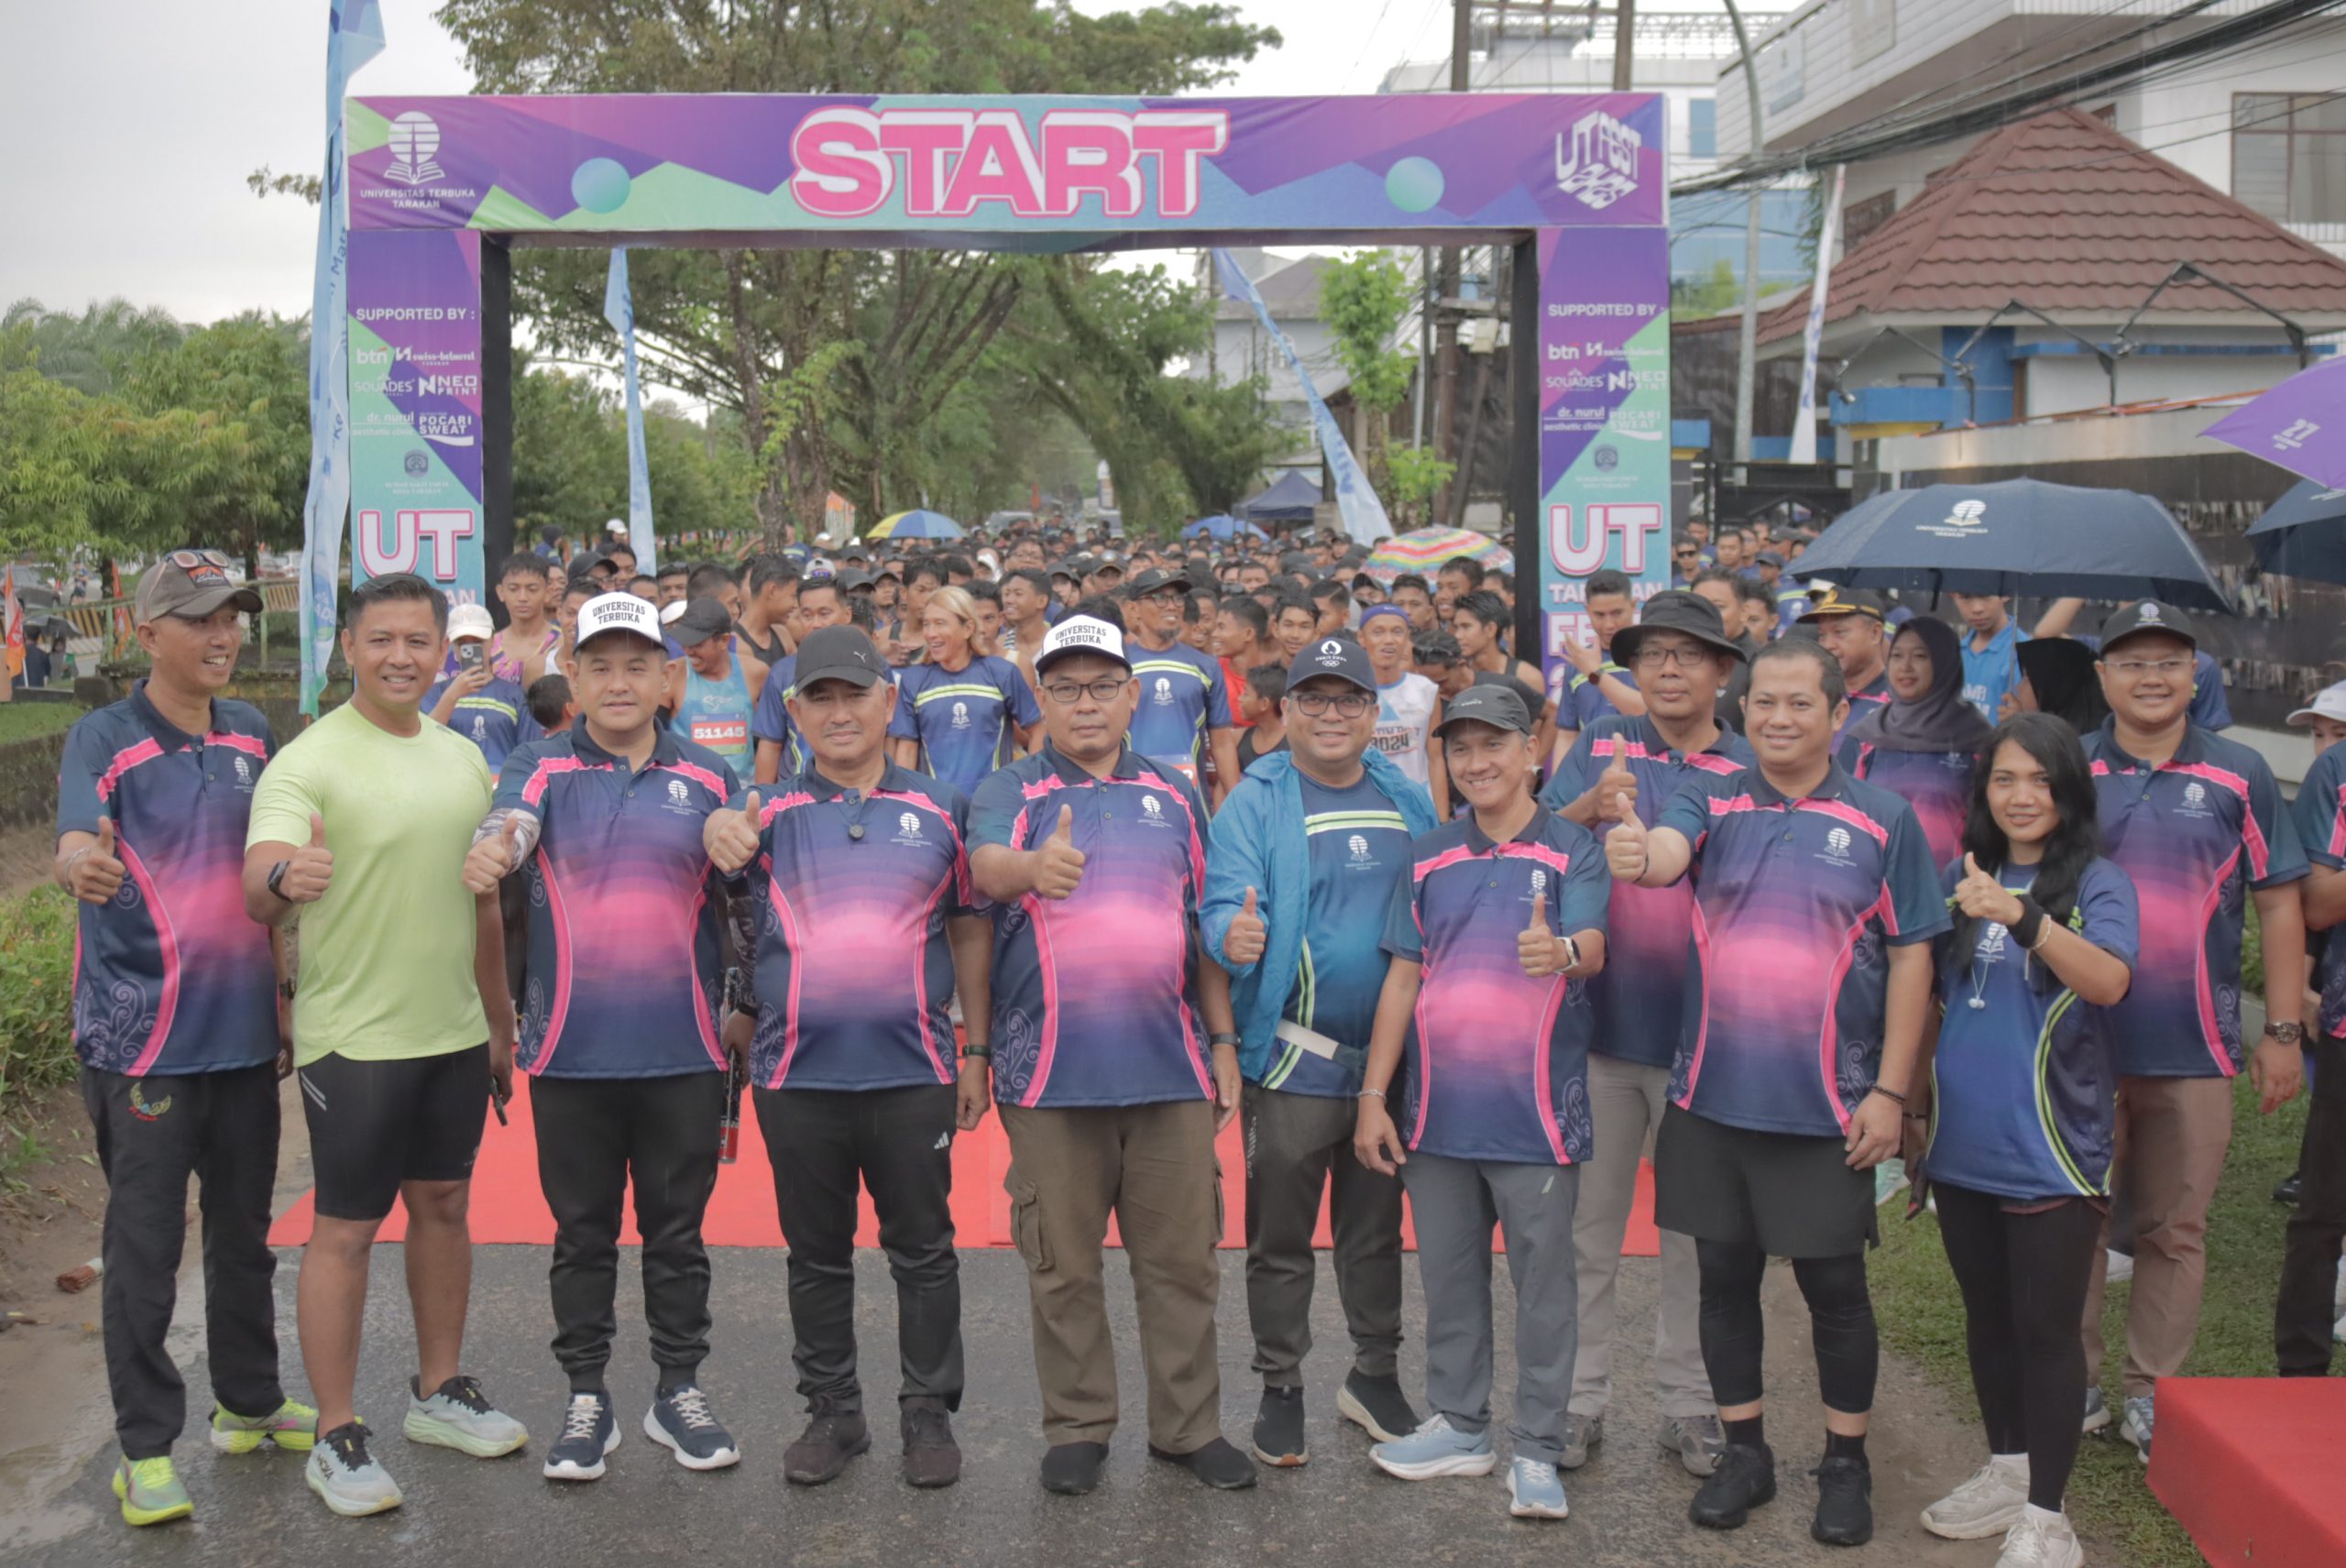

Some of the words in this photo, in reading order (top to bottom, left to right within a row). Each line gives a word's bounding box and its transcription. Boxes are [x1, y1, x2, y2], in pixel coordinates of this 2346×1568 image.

[791, 105, 1231, 219] START
[360, 189, 425, 198] UNIVERSITAS
[429, 189, 476, 198] TERBUKA
[392, 200, 440, 209] TARAKAN
[356, 308, 444, 321] SUPPORTED
[447, 308, 467, 320] BY
[1548, 304, 1634, 317] SUPPORTED
[1637, 304, 1657, 316] BY
[356, 348, 388, 364] btn
[1548, 343, 1580, 359] btn
[437, 375, 477, 387] NEO
[1627, 370, 1666, 382] NEO
[437, 388, 477, 396] PRINT
[419, 415, 472, 425] POCARI
[1609, 411, 1661, 421] POCARI
[420, 425, 467, 434] SWEAT
[2281, 419, 2320, 440] 27
[358, 509, 475, 579] UT
[1549, 502, 1663, 576] UT
[592, 601, 645, 618] UNIVERSITAS
[597, 612, 641, 625] TERBUKA
[1055, 624, 1107, 641] UNIVERSITAS
[1059, 635, 1102, 647] TERBUKA
